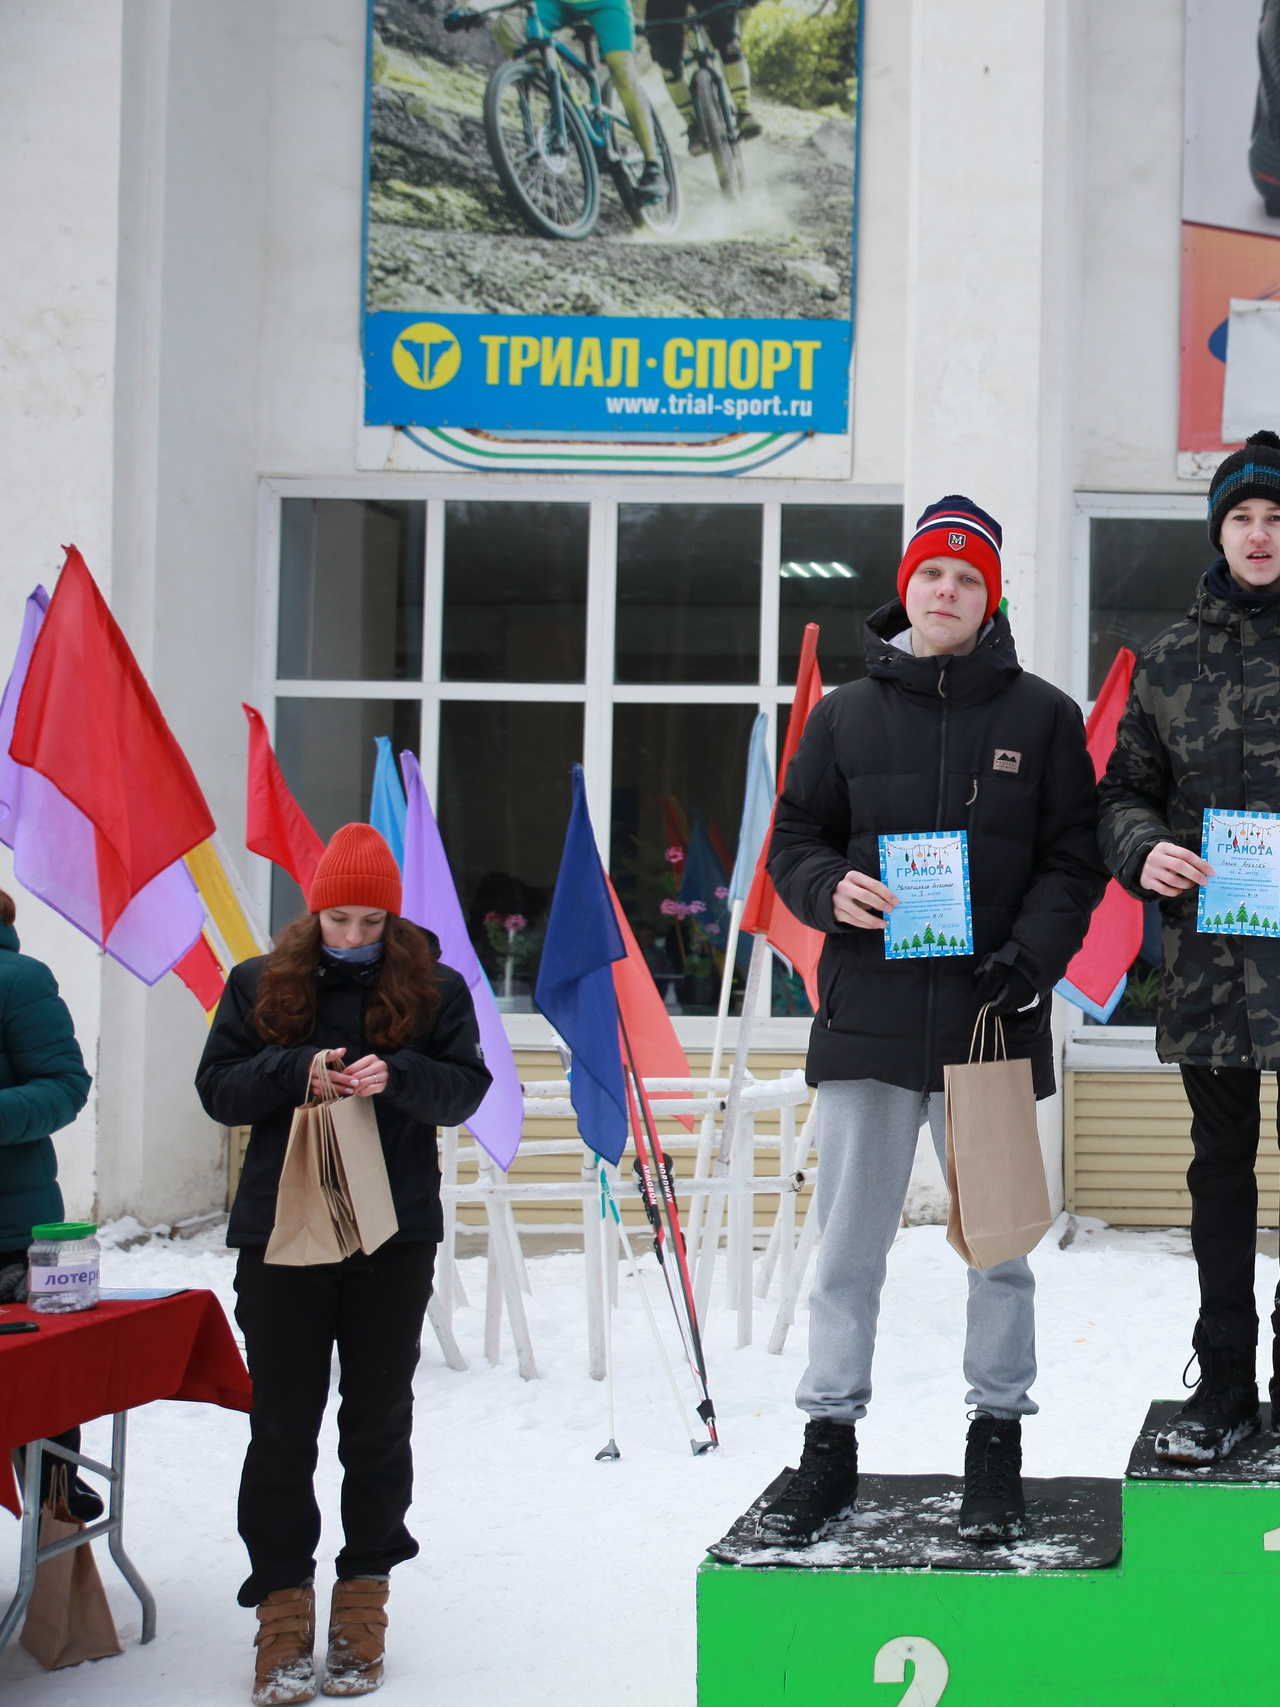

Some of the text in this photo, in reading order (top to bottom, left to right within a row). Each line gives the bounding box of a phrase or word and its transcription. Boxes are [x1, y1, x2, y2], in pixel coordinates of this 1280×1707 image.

[606, 394, 812, 419] www.trial-sport.ru
[1217, 843, 1273, 856] ГРАМОТА
[896, 865, 953, 878] ГРАМОТА
[642, 1164, 658, 1205] NORDWAY
[658, 1162, 674, 1203] NORDWAY
[873, 1636, 950, 1707] 2
